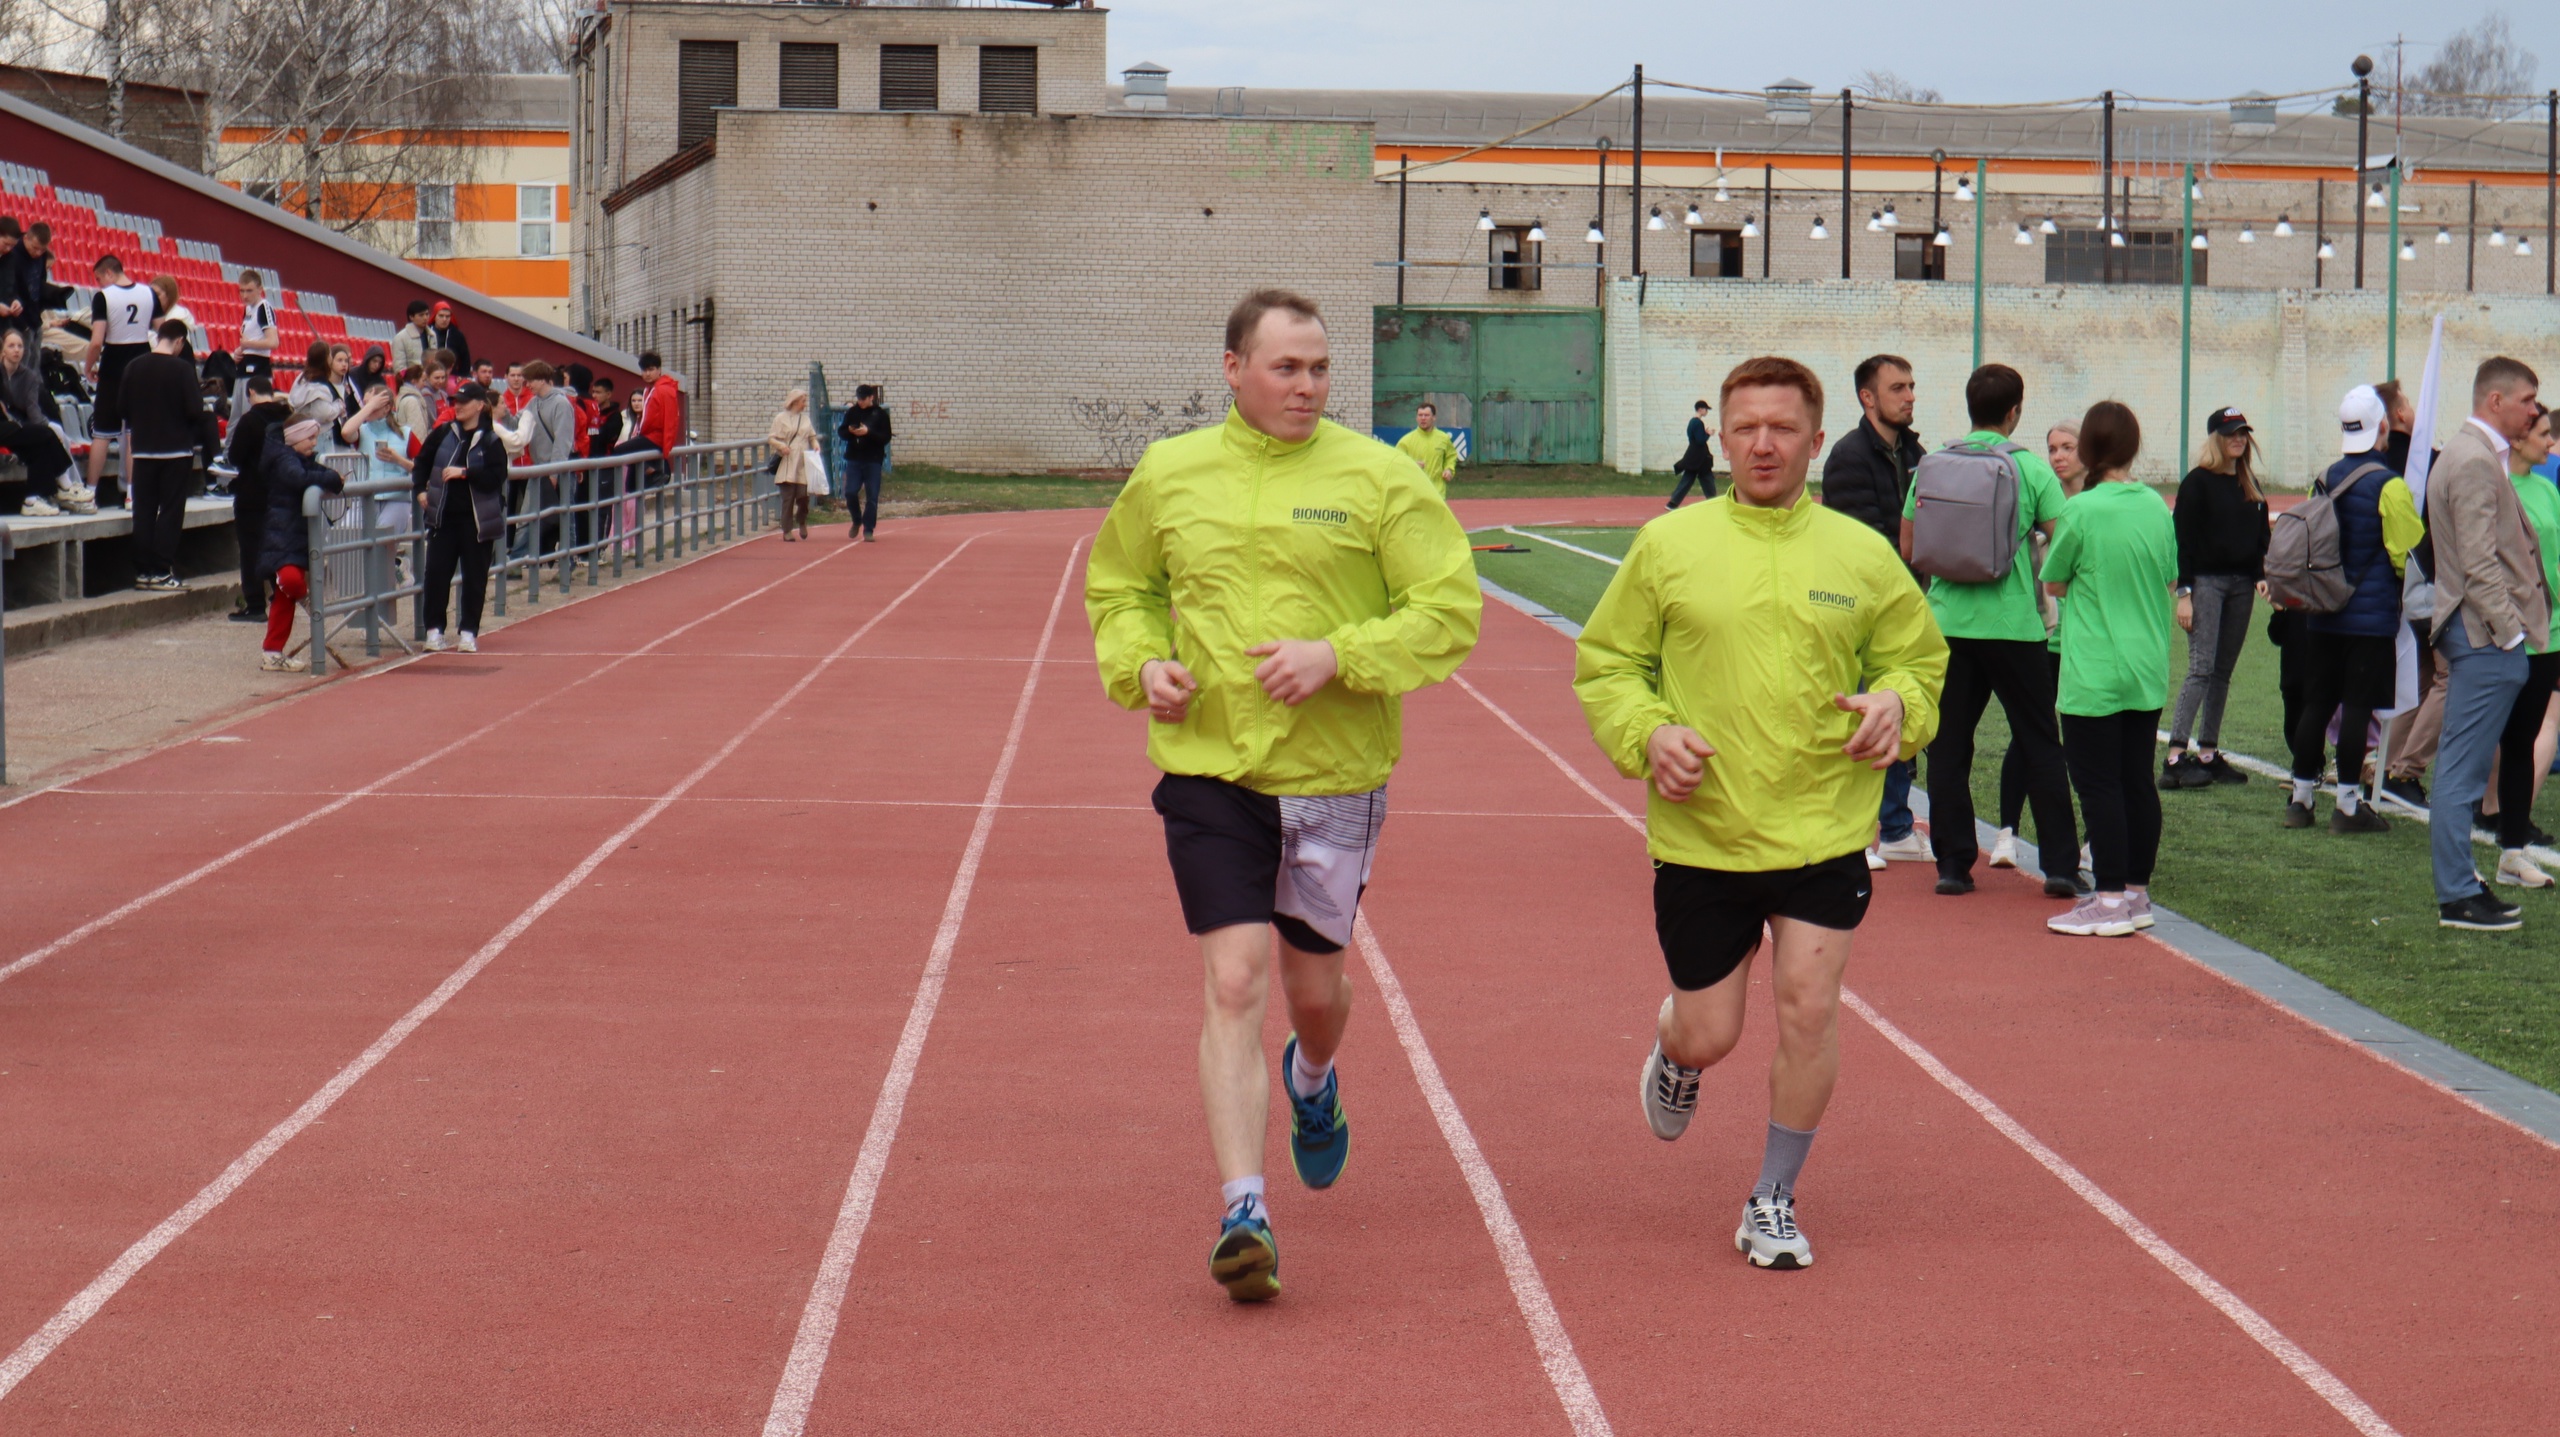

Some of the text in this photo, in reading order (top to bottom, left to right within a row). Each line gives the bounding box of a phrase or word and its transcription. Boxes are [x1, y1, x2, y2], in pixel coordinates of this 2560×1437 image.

[1226, 124, 1371, 180] SVEN
[126, 303, 139, 325] 2
[1292, 507, 1348, 524] BIONORD
[1808, 589, 1855, 609] BIONORD
